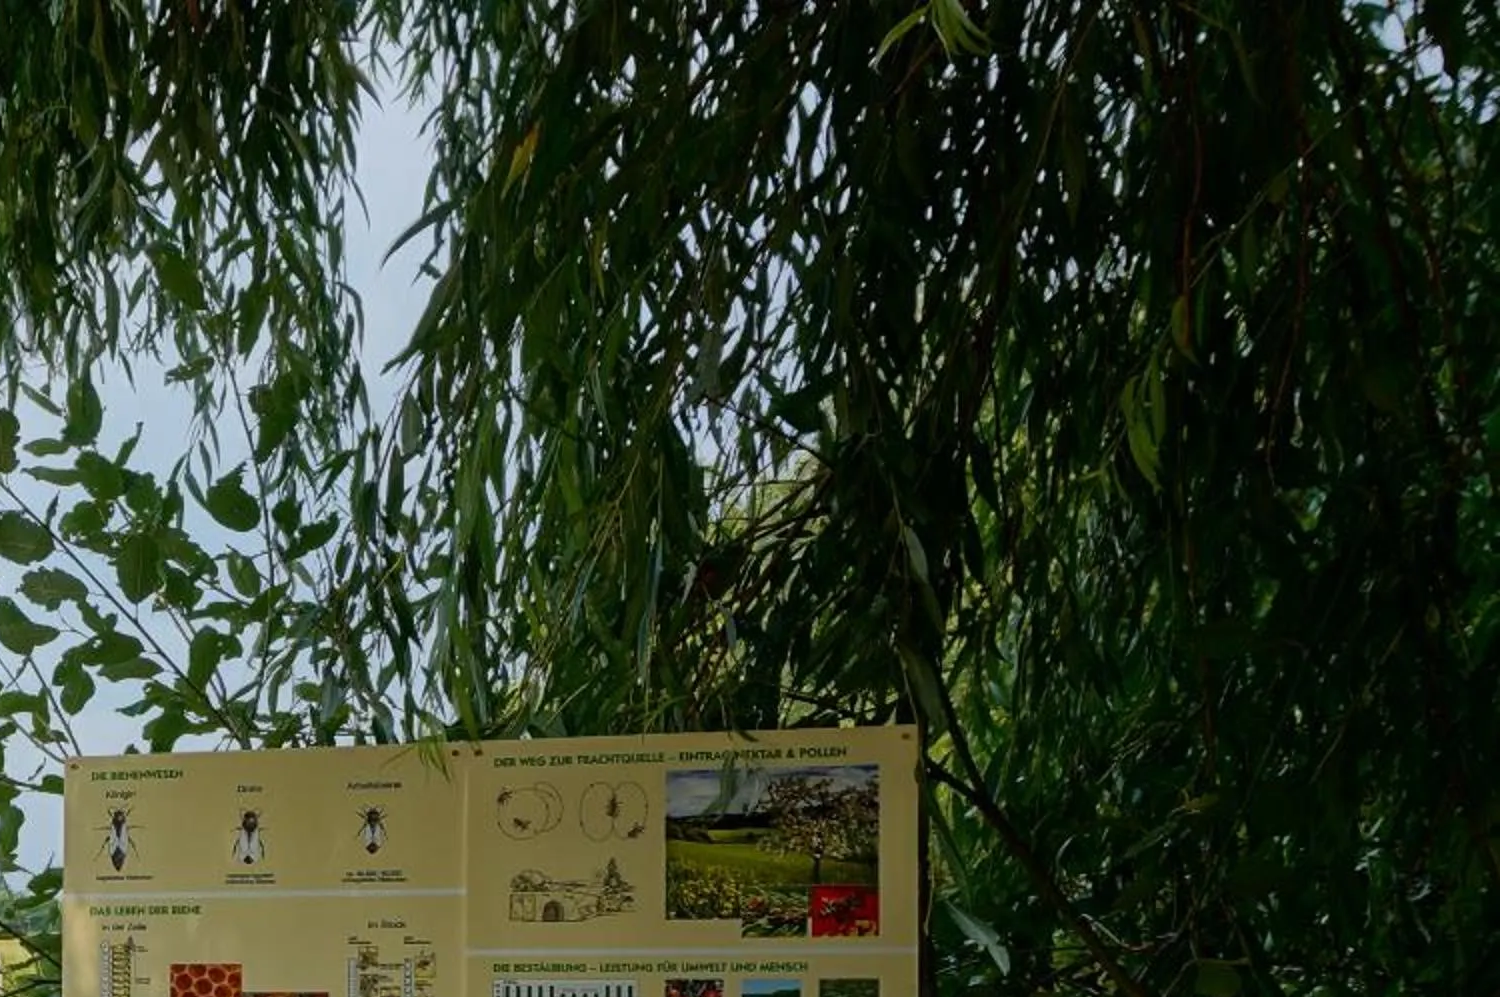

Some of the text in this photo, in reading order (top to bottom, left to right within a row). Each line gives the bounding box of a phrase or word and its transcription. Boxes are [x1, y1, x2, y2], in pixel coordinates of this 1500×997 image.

[494, 756, 516, 767] DER
[521, 755, 546, 767] WEG
[550, 755, 573, 766] ZUR
[800, 746, 847, 758] POLLEN
[90, 904, 203, 916] DAS LEBEN DER BIENE
[600, 963, 653, 973] LEISTUNG
[657, 960, 677, 973] FÜR
[682, 962, 728, 972] UMWELT
[731, 962, 756, 972] UND
[759, 962, 808, 973] MENSCH
